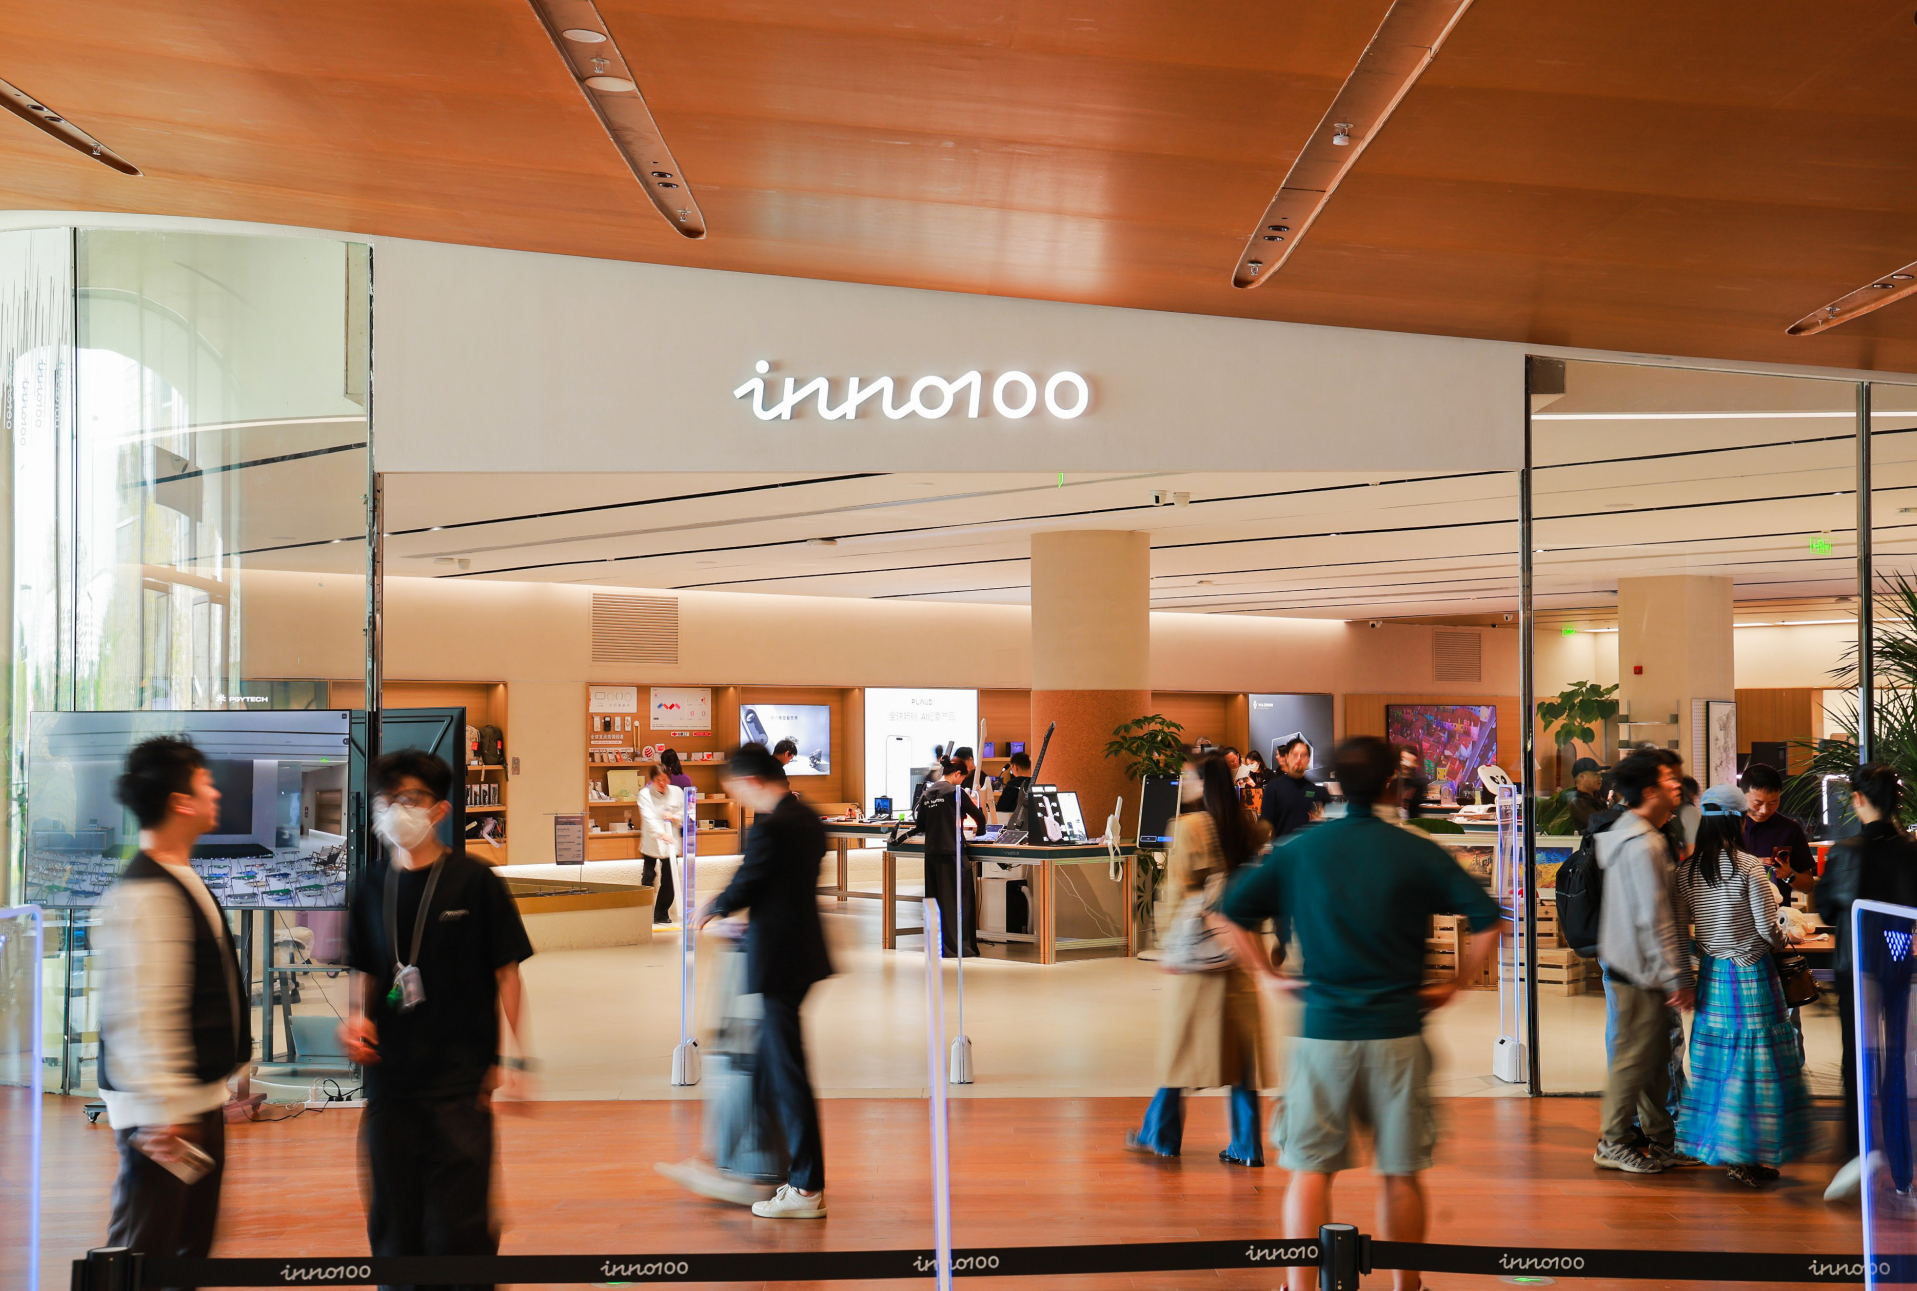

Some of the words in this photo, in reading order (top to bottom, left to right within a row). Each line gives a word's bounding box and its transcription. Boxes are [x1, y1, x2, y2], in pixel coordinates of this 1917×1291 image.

[732, 359, 1089, 421] inno100
[20, 377, 30, 446] inno100
[911, 698, 933, 706] PLAUD
[1245, 1245, 1319, 1261] inno10
[1498, 1253, 1585, 1270] inno100
[600, 1260, 689, 1276] inno100
[913, 1255, 1000, 1272] ino100
[1808, 1259, 1891, 1276] inno00
[280, 1264, 372, 1281] inno100
